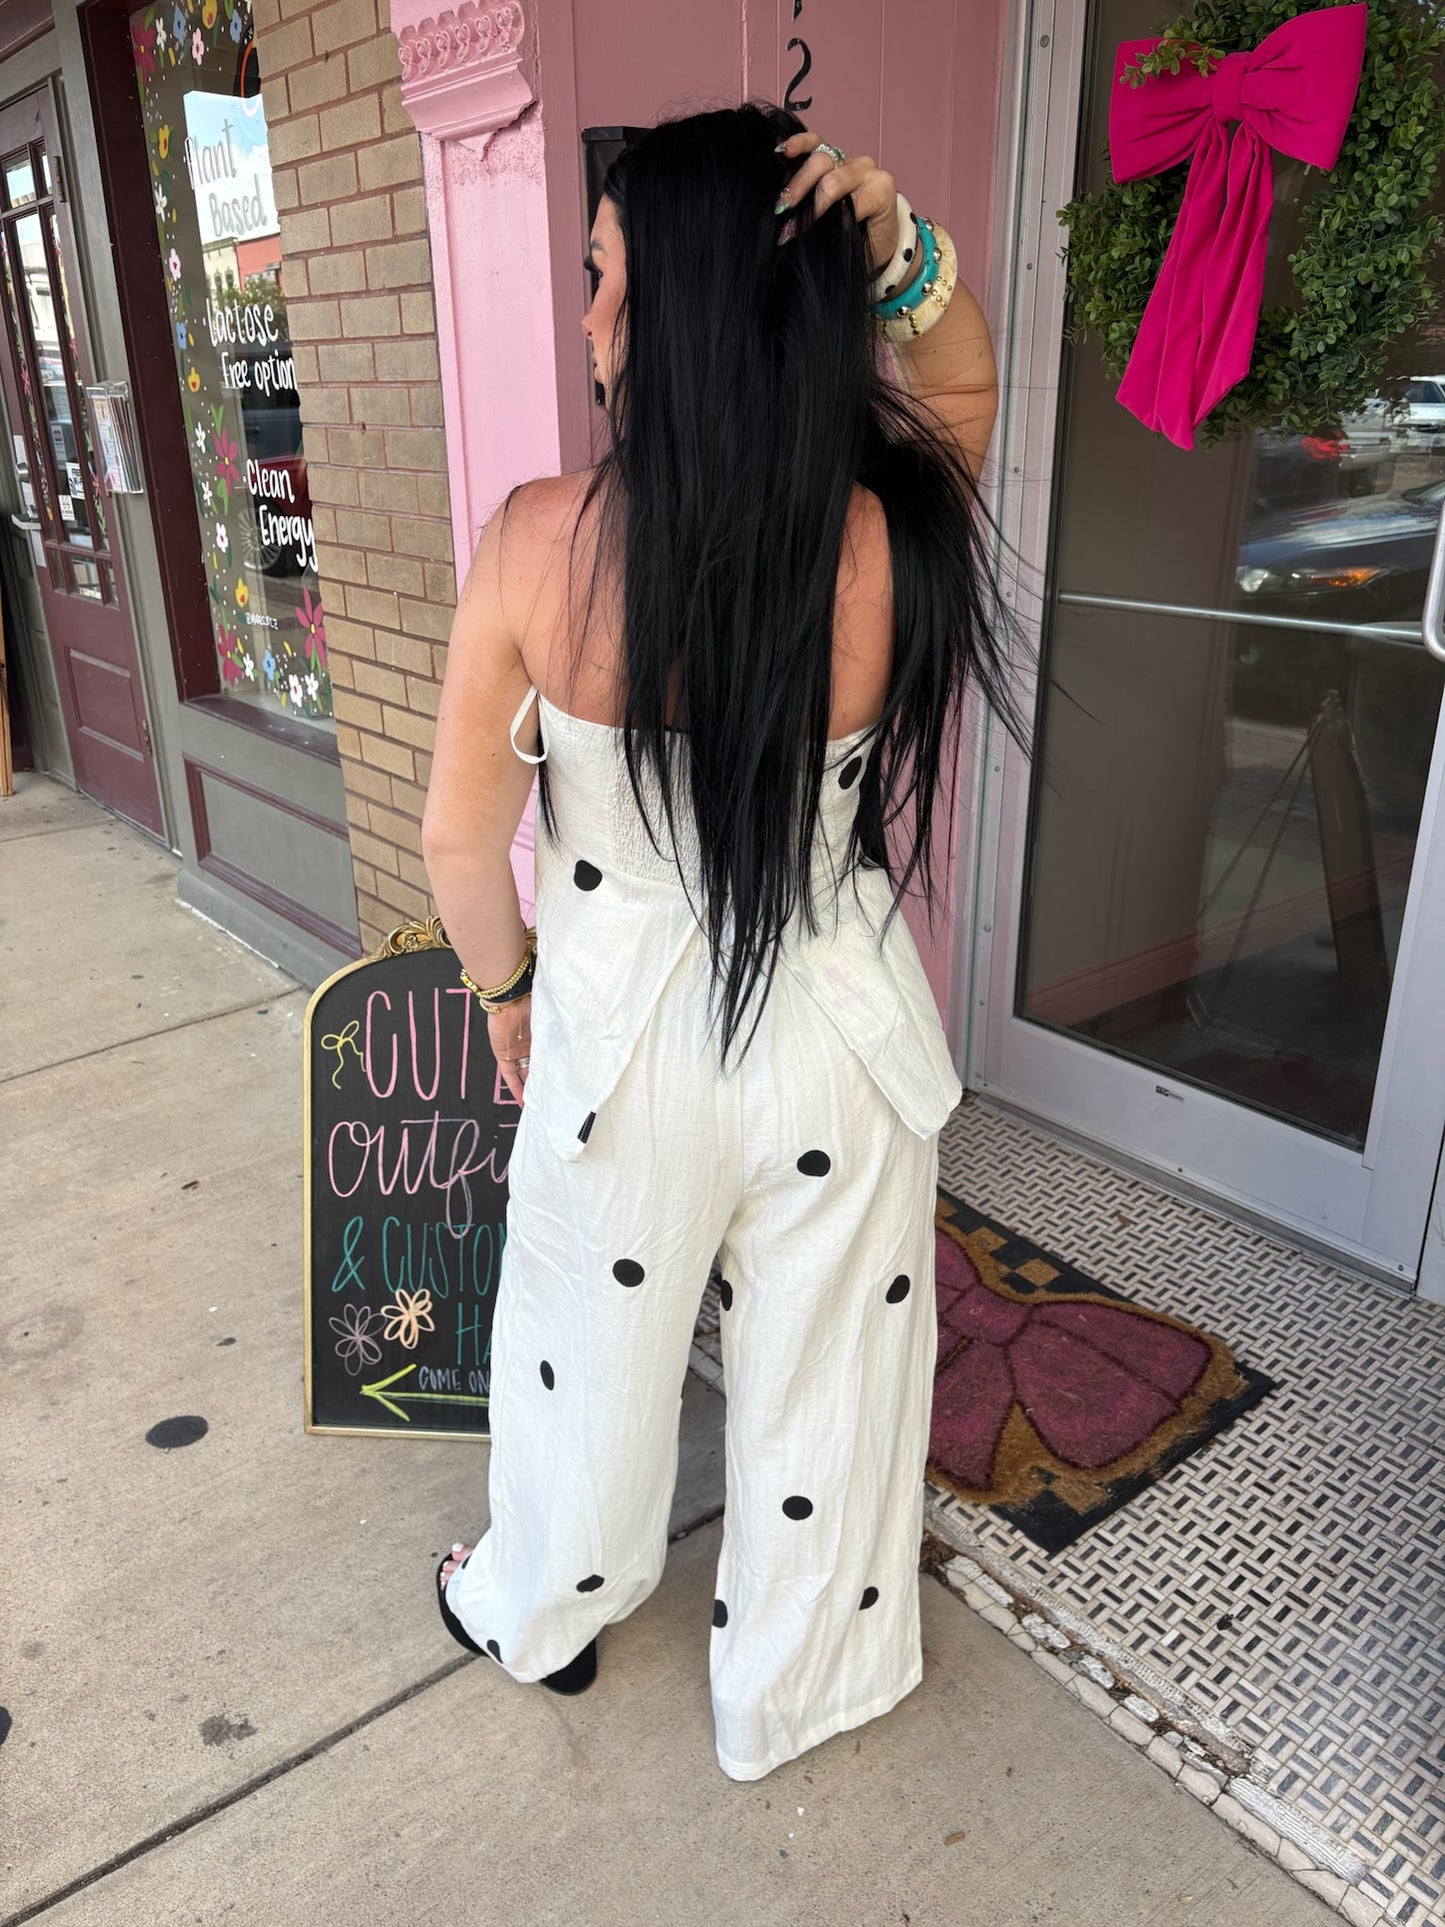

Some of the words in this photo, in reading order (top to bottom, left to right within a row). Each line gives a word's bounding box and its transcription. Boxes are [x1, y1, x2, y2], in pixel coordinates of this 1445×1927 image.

[784, 0, 812, 112] 2
[184, 118, 237, 190] Plant
[208, 173, 268, 238] Based
[221, 351, 251, 389] Free
[246, 459, 295, 503] Clean
[259, 504, 318, 572] Energy
[331, 1216, 366, 1292] &
[419, 1365, 462, 1391] COME
